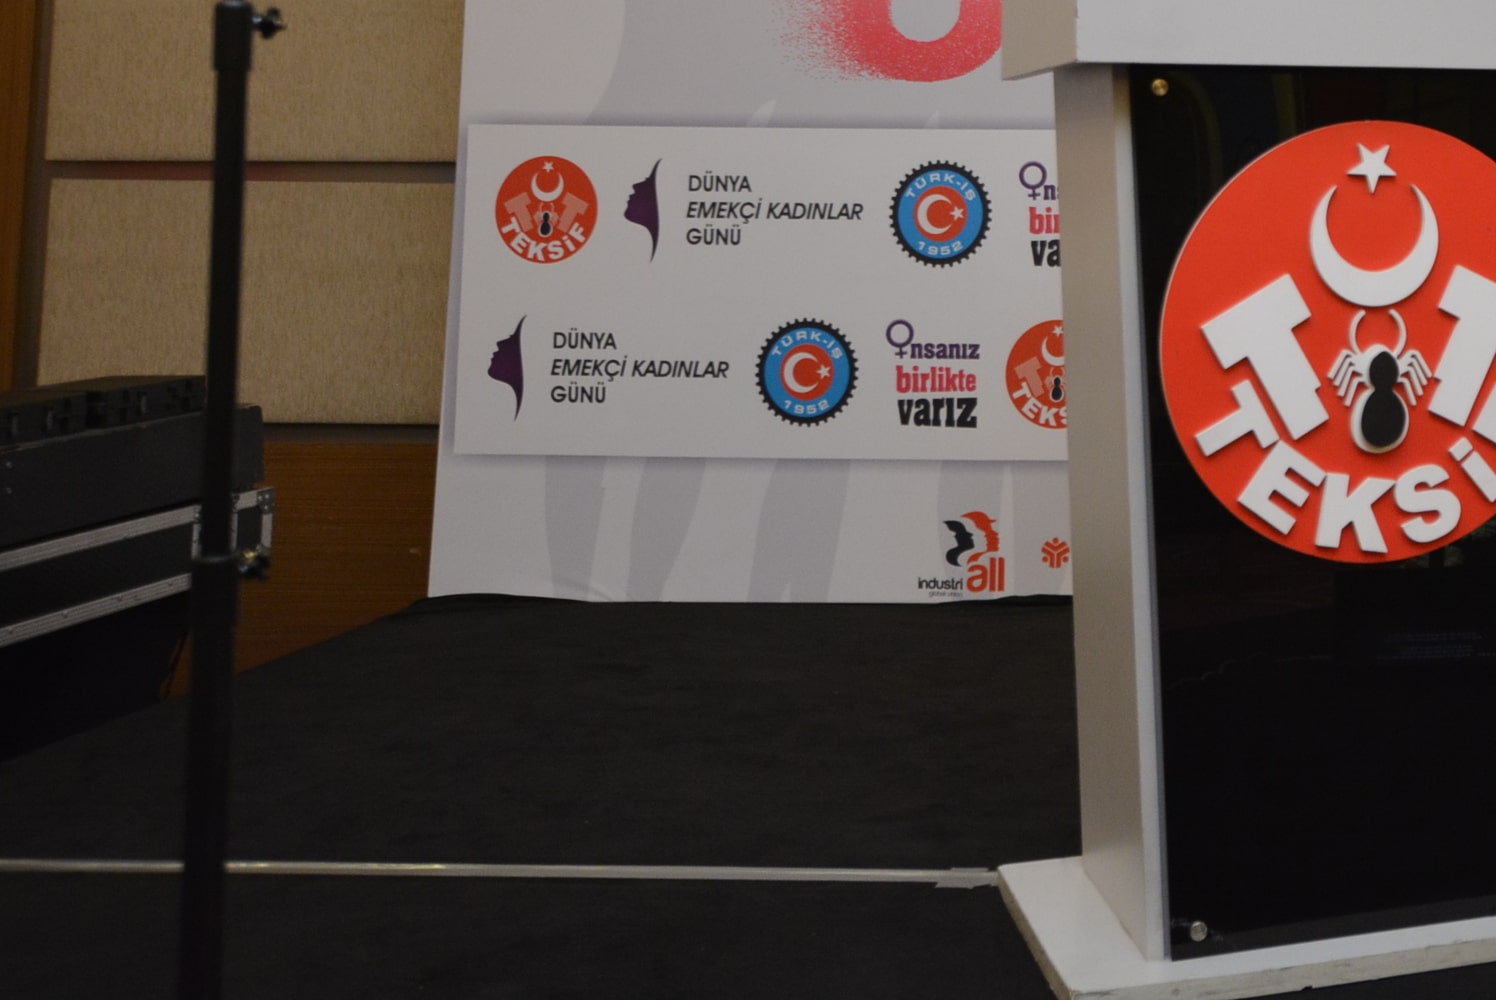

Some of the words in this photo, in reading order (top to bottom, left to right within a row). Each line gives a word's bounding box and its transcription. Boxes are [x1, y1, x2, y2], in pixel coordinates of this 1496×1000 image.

[688, 170, 752, 192] DÜNYA
[686, 197, 763, 224] EMEKÇİ
[766, 202, 864, 220] KADINLAR
[686, 223, 741, 246] GÜNÜ
[553, 327, 617, 350] DÜNYA
[550, 355, 628, 382] EMEKÇİ
[631, 360, 730, 378] KADINLAR
[896, 365, 977, 393] birlikte
[550, 381, 606, 404] GÜNÜ
[897, 397, 978, 428] varız
[918, 577, 964, 591] industri
[966, 556, 1006, 593] all
